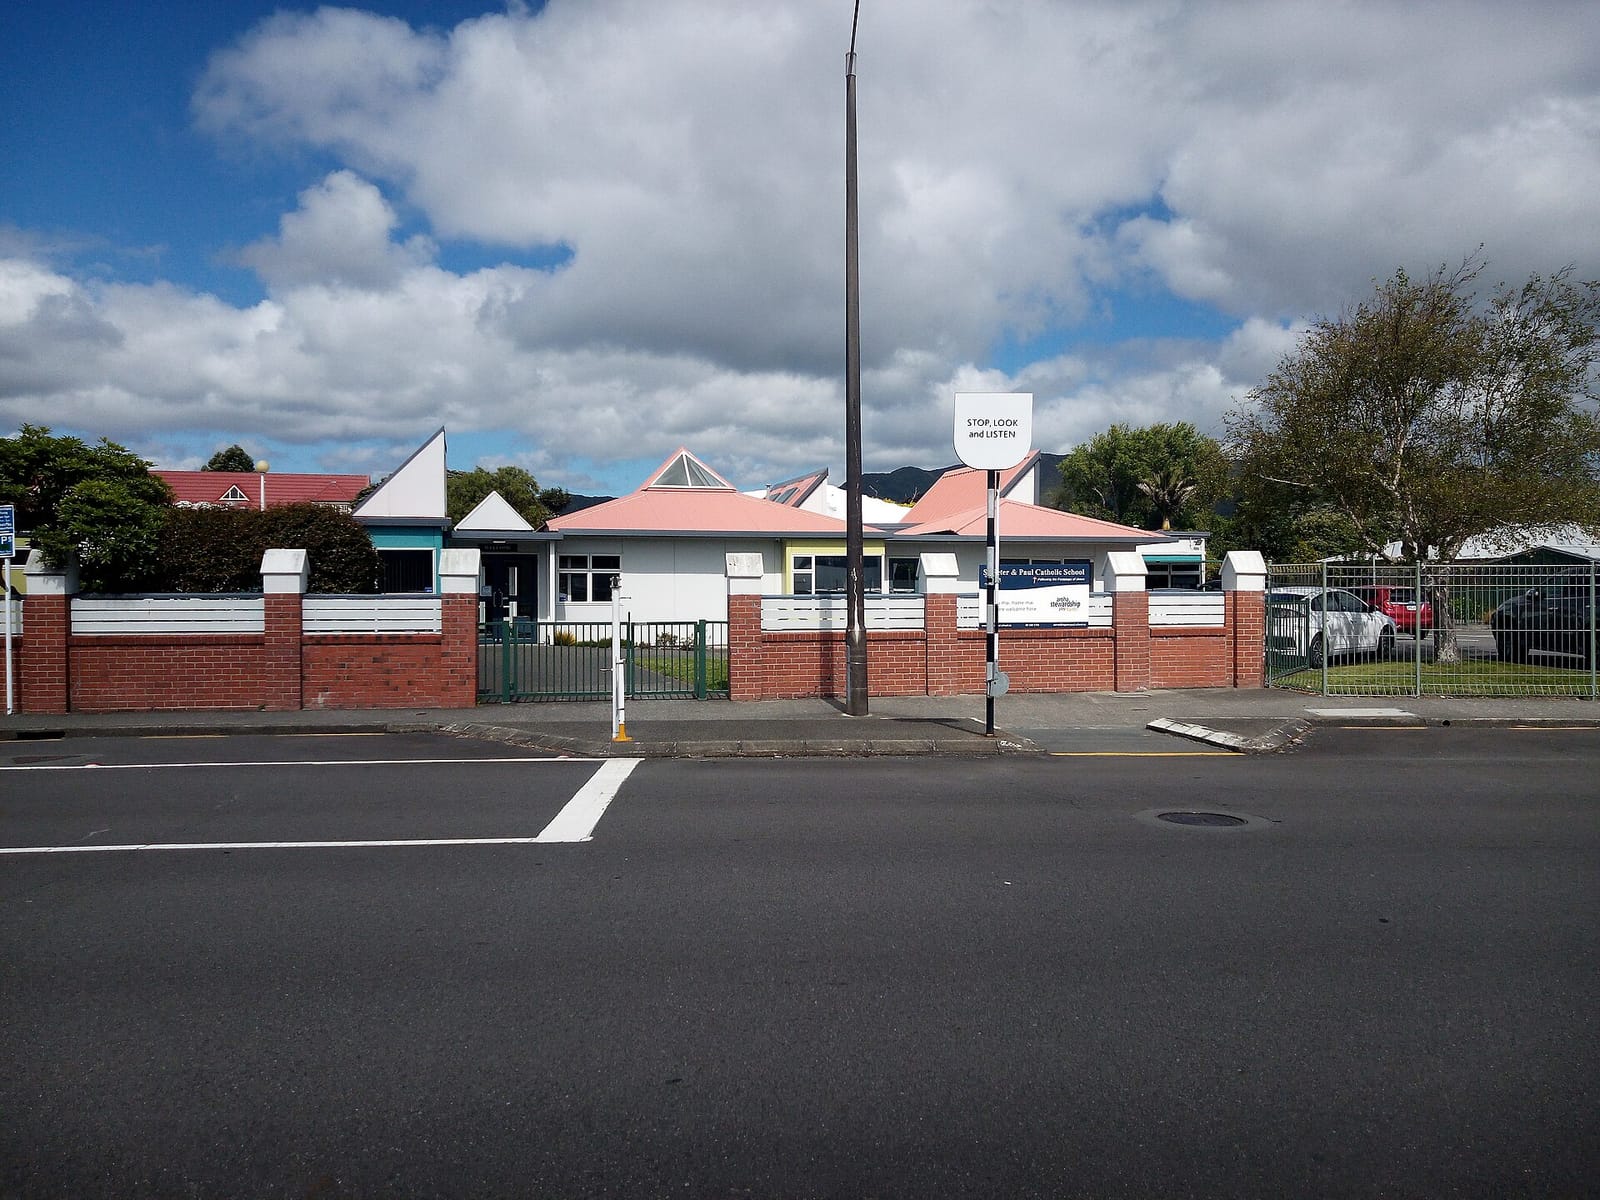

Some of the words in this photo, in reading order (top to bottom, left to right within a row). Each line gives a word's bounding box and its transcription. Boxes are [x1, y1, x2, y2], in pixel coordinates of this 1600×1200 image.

[967, 418, 992, 428] STOP,
[993, 418, 1018, 427] LOOK
[968, 430, 984, 439] and
[986, 430, 1016, 439] LISTEN
[1010, 568, 1018, 576] &
[1019, 568, 1034, 576] Paul
[1034, 568, 1062, 576] Catholic
[1062, 568, 1085, 576] School
[1050, 600, 1081, 608] stewardship
